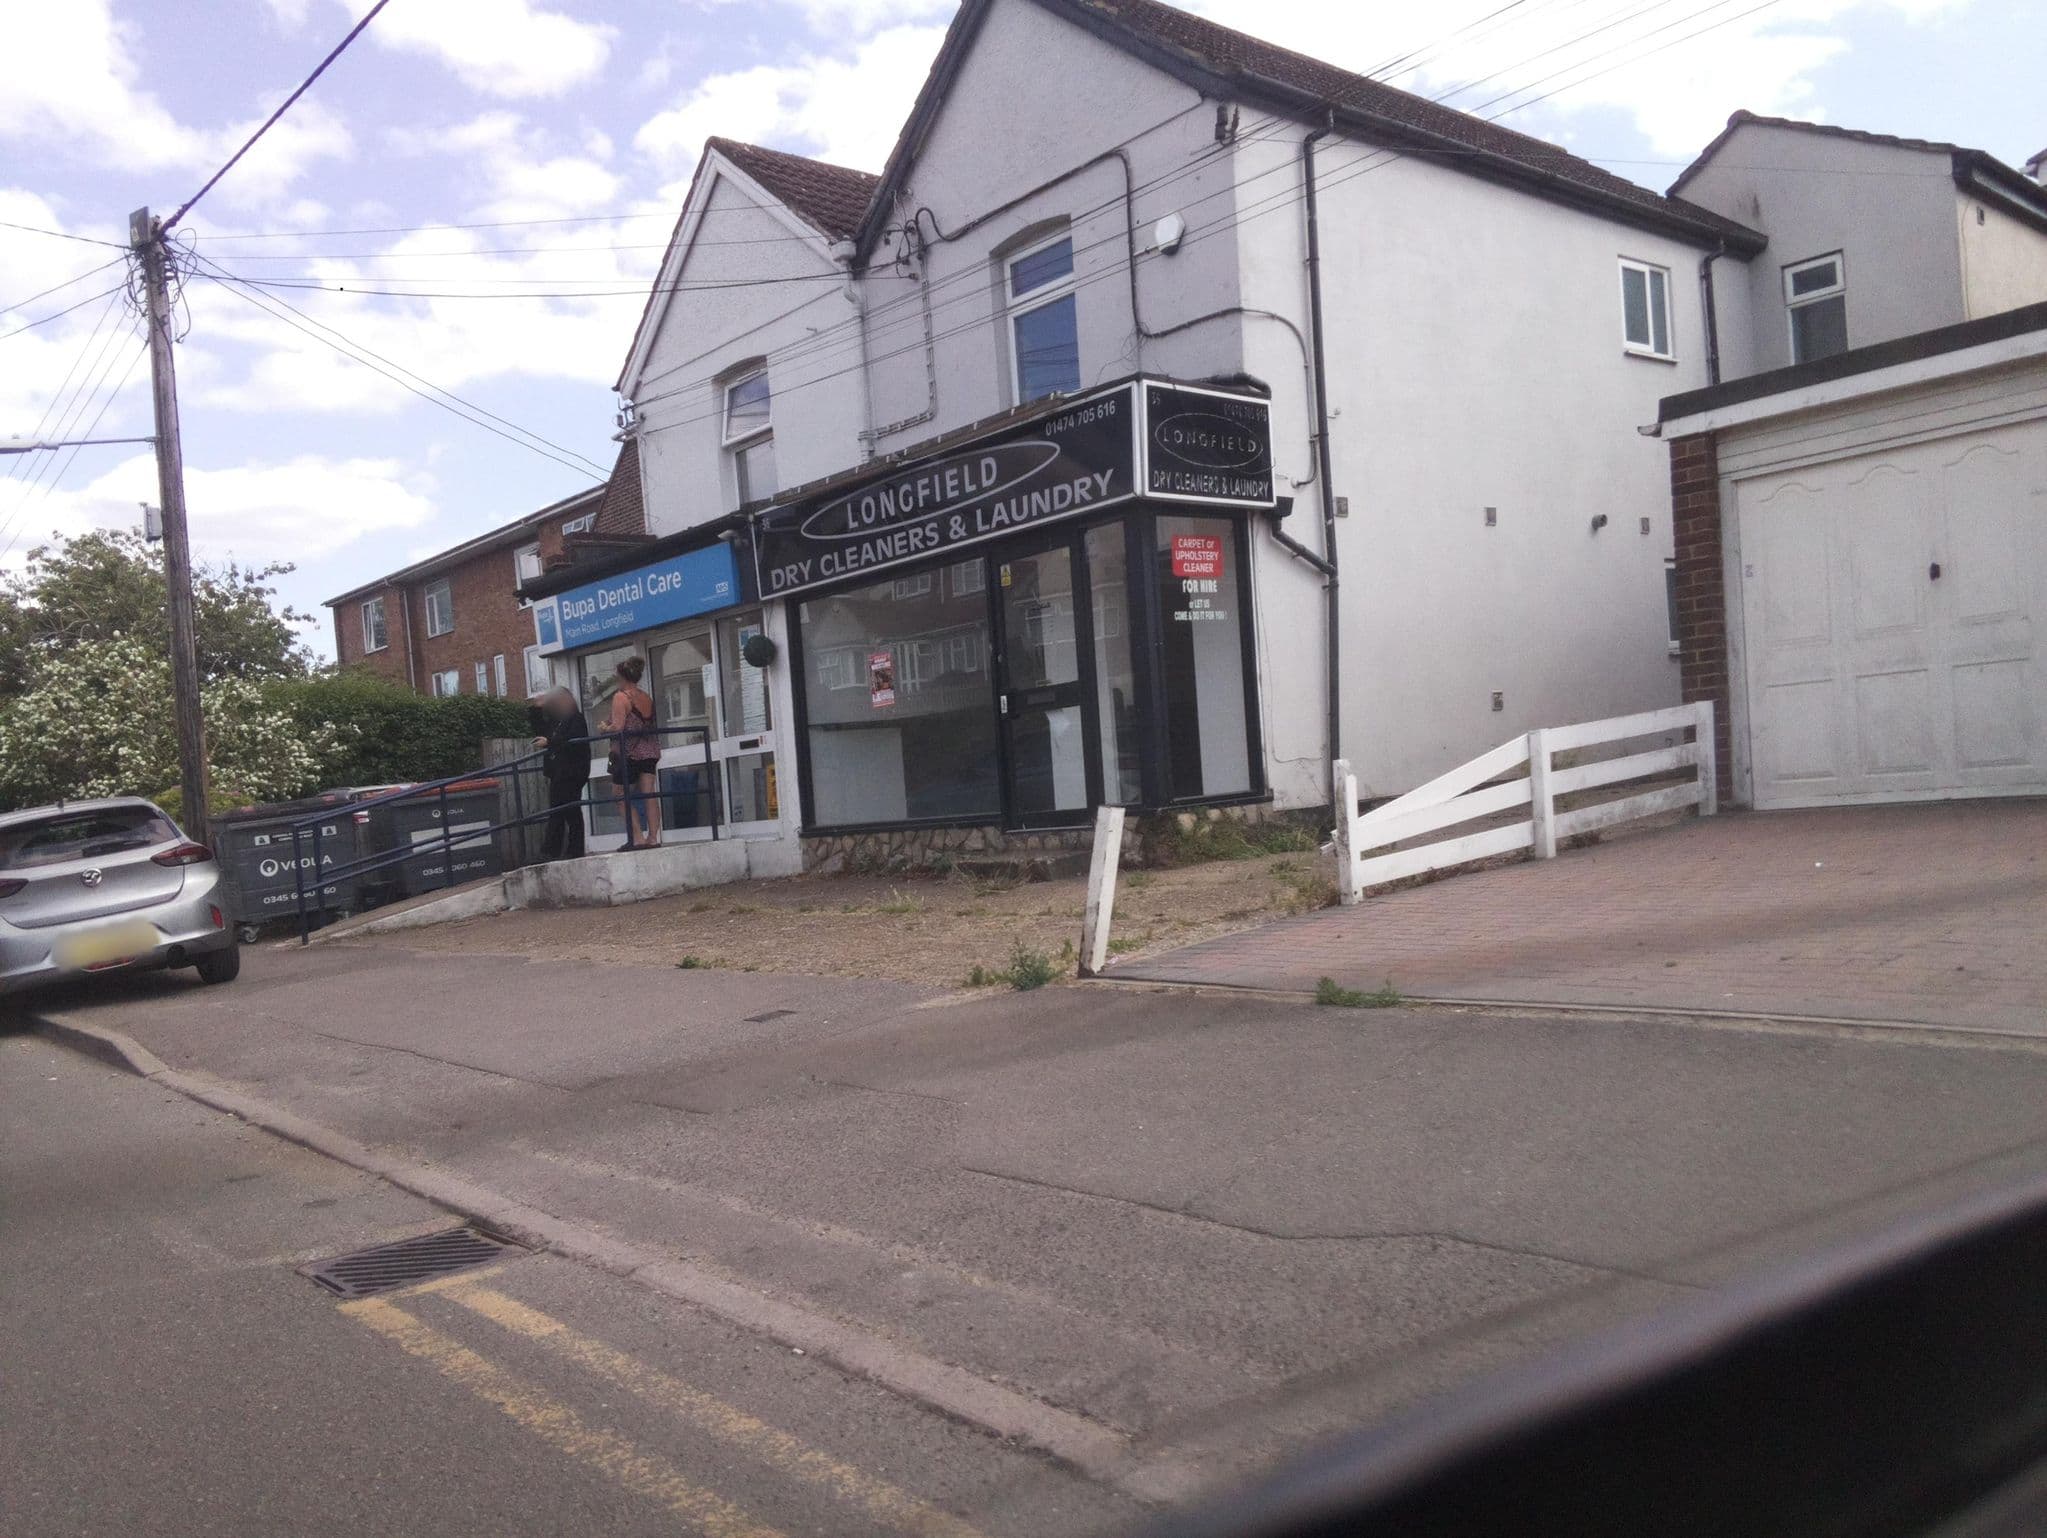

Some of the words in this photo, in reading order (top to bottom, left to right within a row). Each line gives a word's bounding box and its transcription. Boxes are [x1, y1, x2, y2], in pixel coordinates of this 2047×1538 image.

[1045, 414, 1075, 437] 01474
[1077, 409, 1095, 425] 705
[1097, 400, 1116, 418] 616
[1163, 427, 1257, 453] LONGFIELD
[846, 456, 997, 529] LONGFIELD
[1153, 470, 1171, 488] DRY
[1175, 471, 1219, 494] CLEANERS
[1222, 476, 1228, 494] &
[1229, 477, 1269, 497] LAUNDRY
[771, 559, 812, 590] DRY
[820, 522, 940, 576] CLEANERS
[949, 515, 968, 539] &
[976, 468, 1114, 532] LAUNDRY
[1177, 538, 1206, 549] CARPET
[1175, 550, 1219, 561] UPHOLSTERY
[1183, 562, 1214, 573] CLEANER
[1182, 579, 1198, 593] FOR
[1200, 579, 1217, 593] HIRE
[562, 597, 596, 621] Bupa
[598, 577, 643, 610] Dental
[647, 571, 682, 595] Care
[602, 611, 634, 631] Longfield
[280, 855, 333, 871] VEOLA
[422, 866, 444, 876] 0345
[469, 860, 486, 868] 460
[263, 894, 289, 904] 0345
